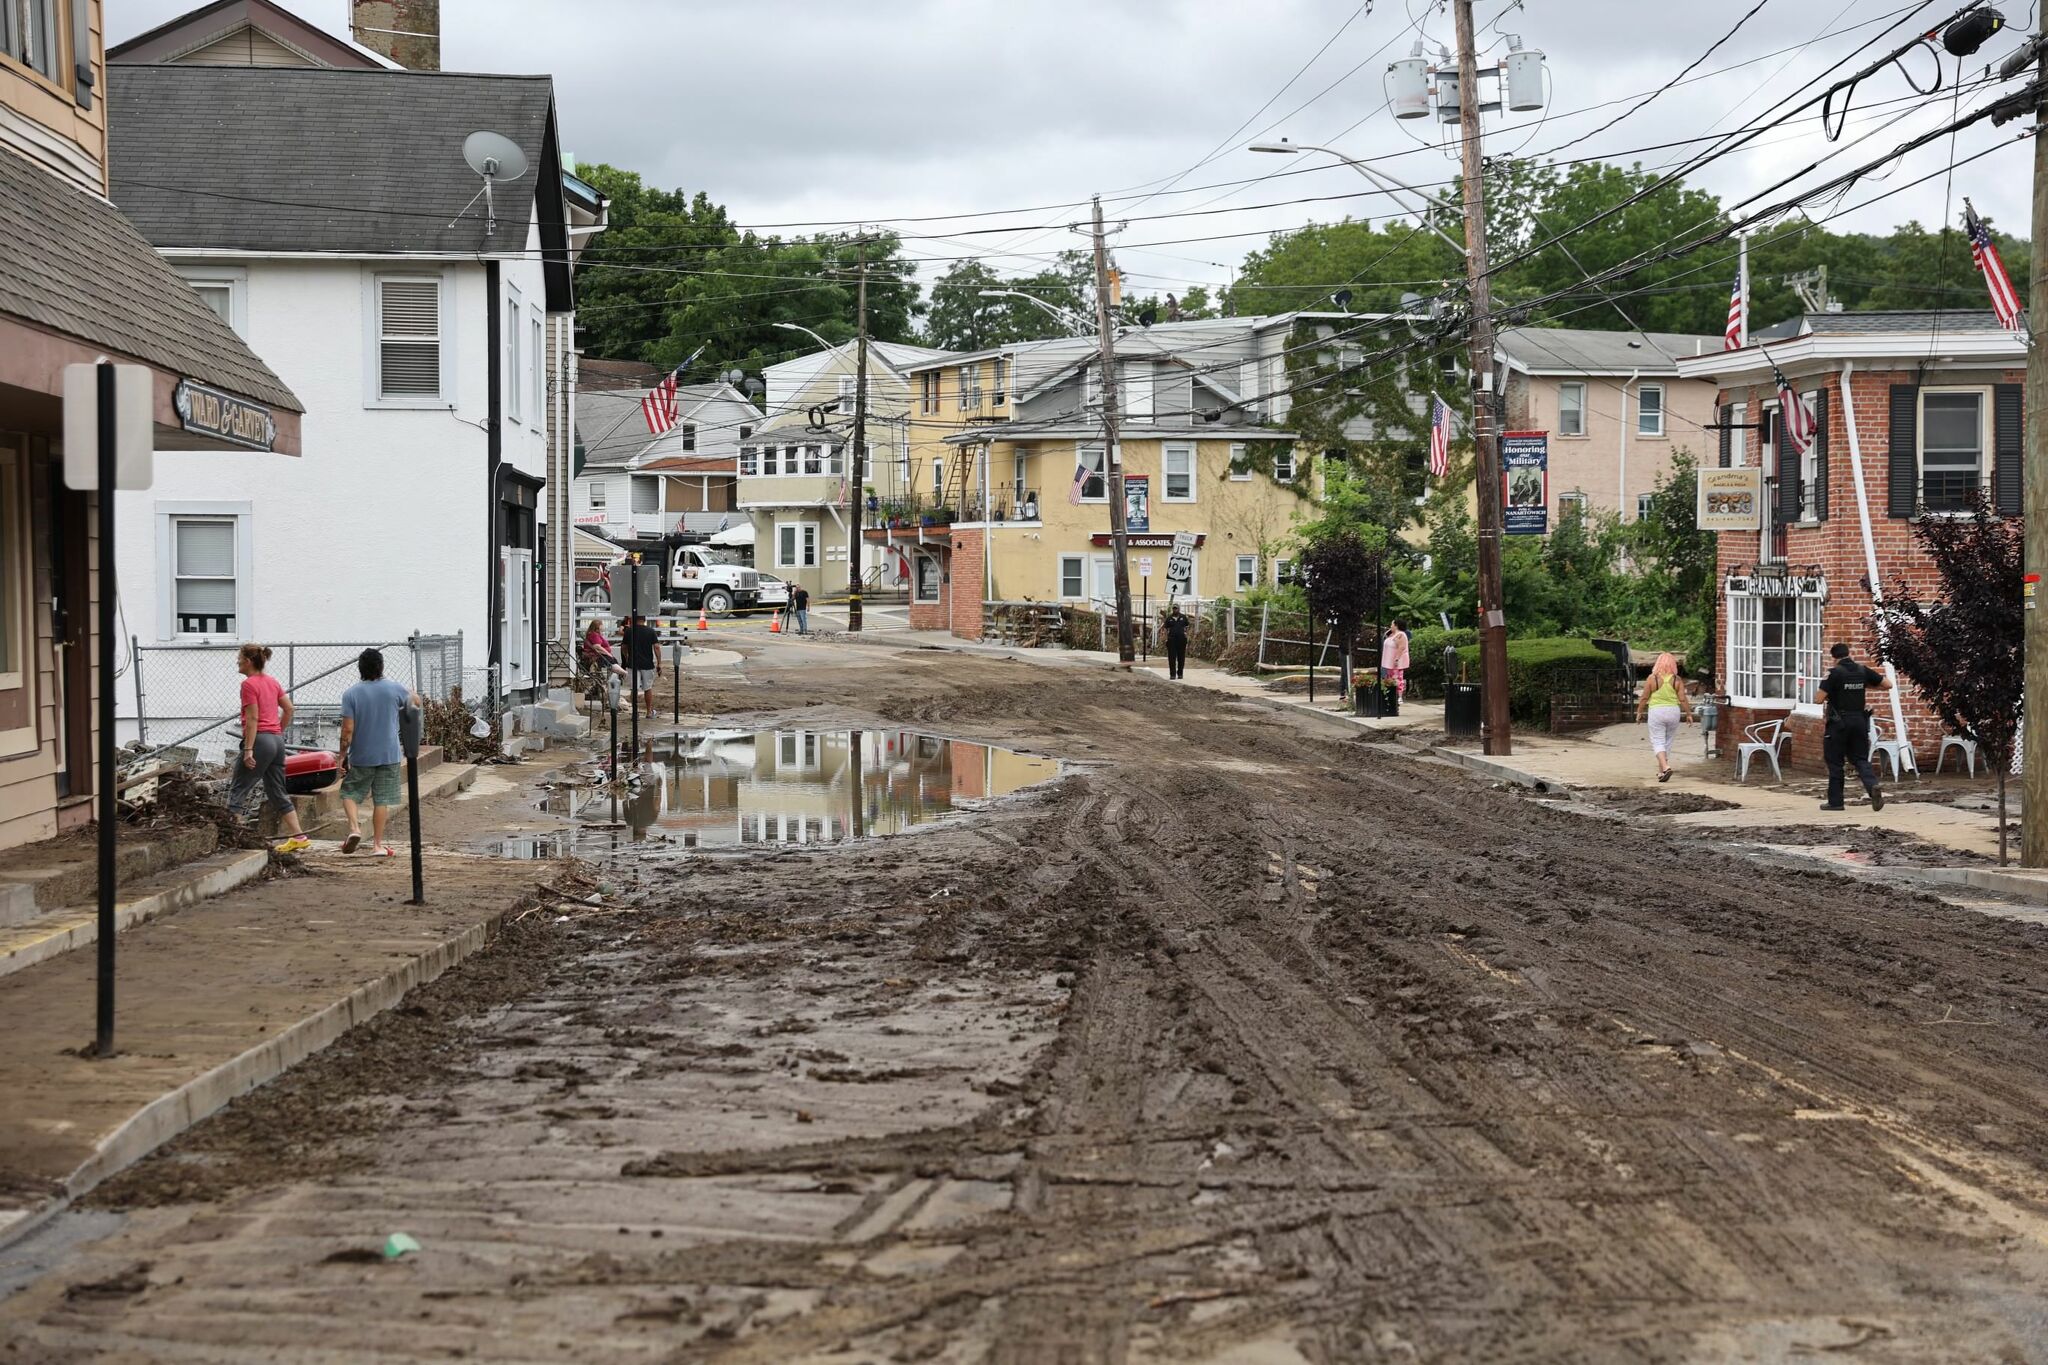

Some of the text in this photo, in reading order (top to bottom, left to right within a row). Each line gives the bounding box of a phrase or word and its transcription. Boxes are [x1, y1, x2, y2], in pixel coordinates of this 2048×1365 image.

[190, 389, 266, 443] WARD & GARVEY
[1504, 445, 1546, 454] Honoring
[1508, 457, 1541, 466] Military
[1173, 545, 1192, 557] JCT
[1171, 563, 1188, 577] 9W
[1843, 682, 1865, 690] POLICE
